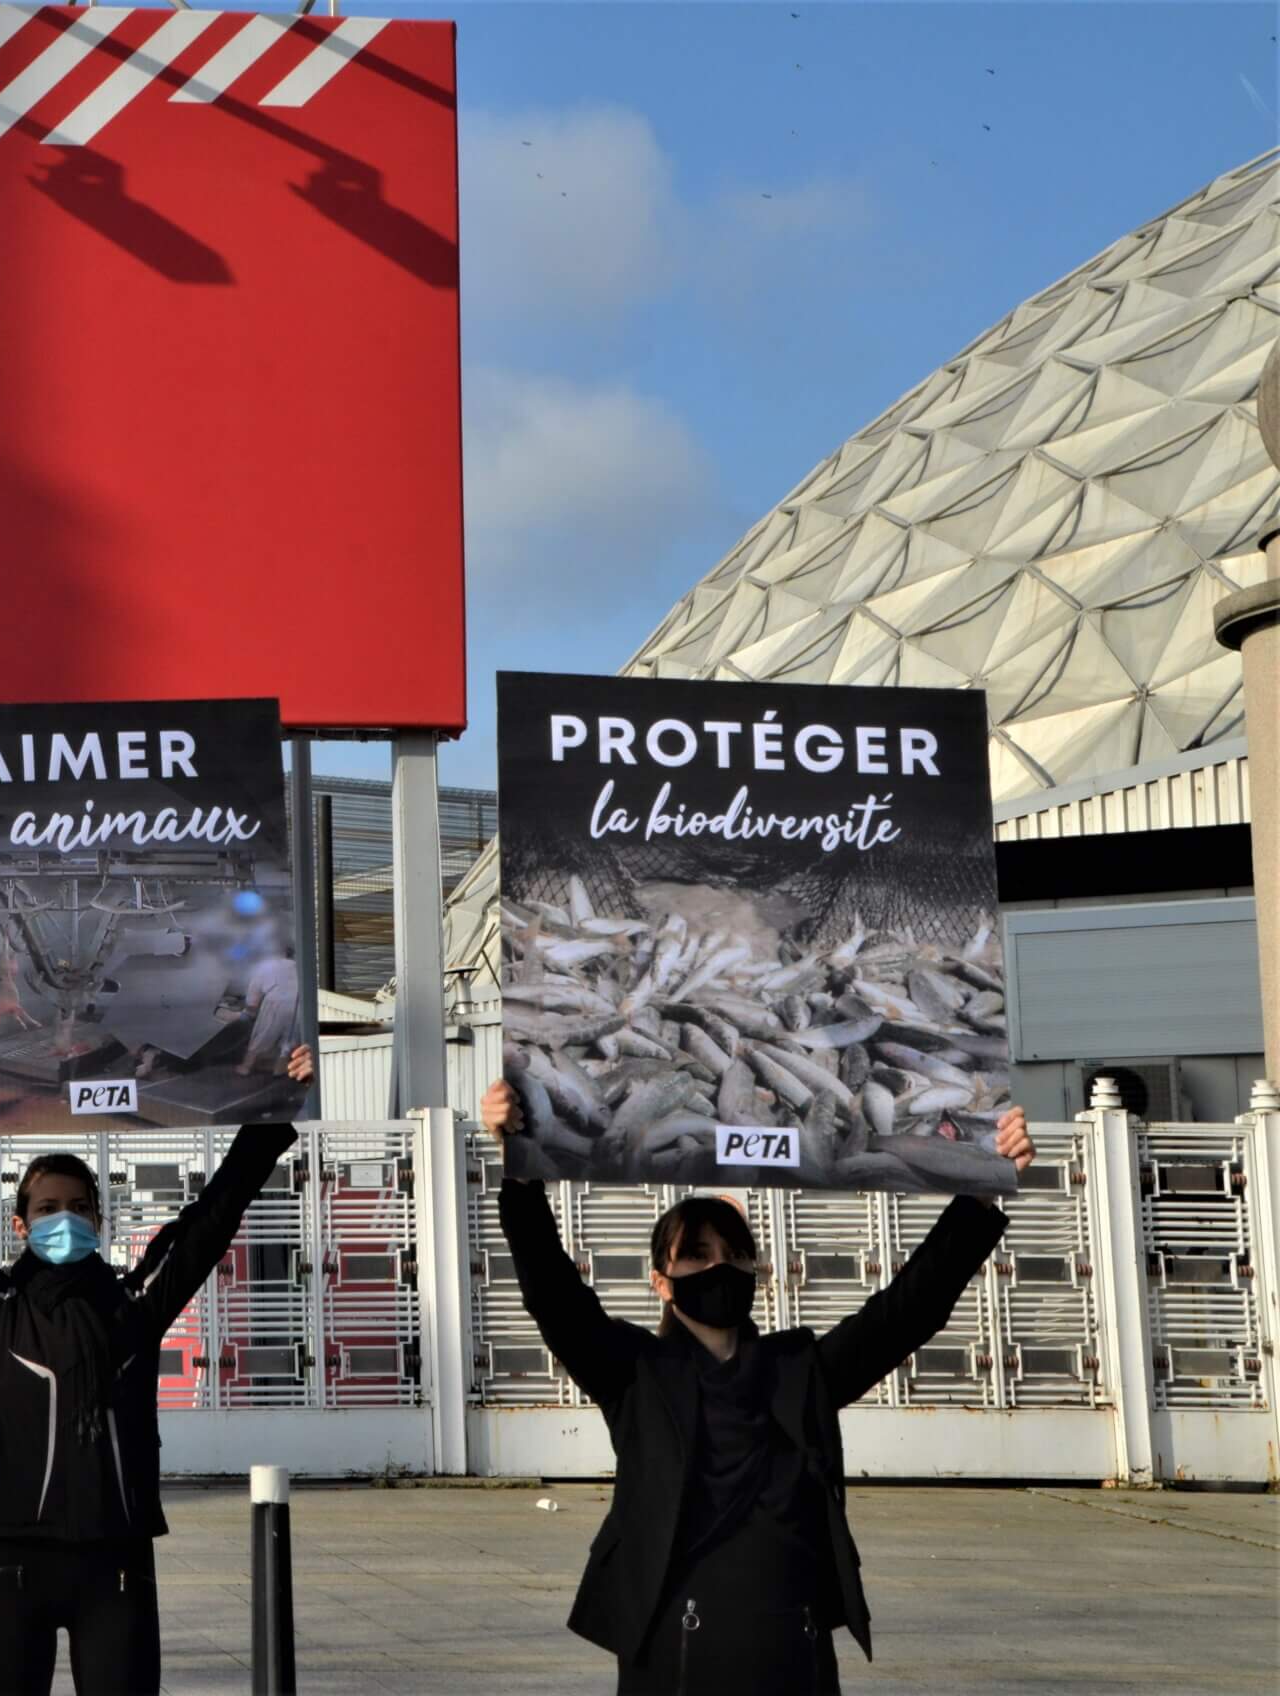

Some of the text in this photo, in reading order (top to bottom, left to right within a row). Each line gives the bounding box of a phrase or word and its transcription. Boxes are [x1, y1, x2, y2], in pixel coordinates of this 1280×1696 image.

[550, 710, 942, 777] PROTÉGER
[10, 799, 261, 854] animaux
[589, 779, 902, 852] la biodiversité
